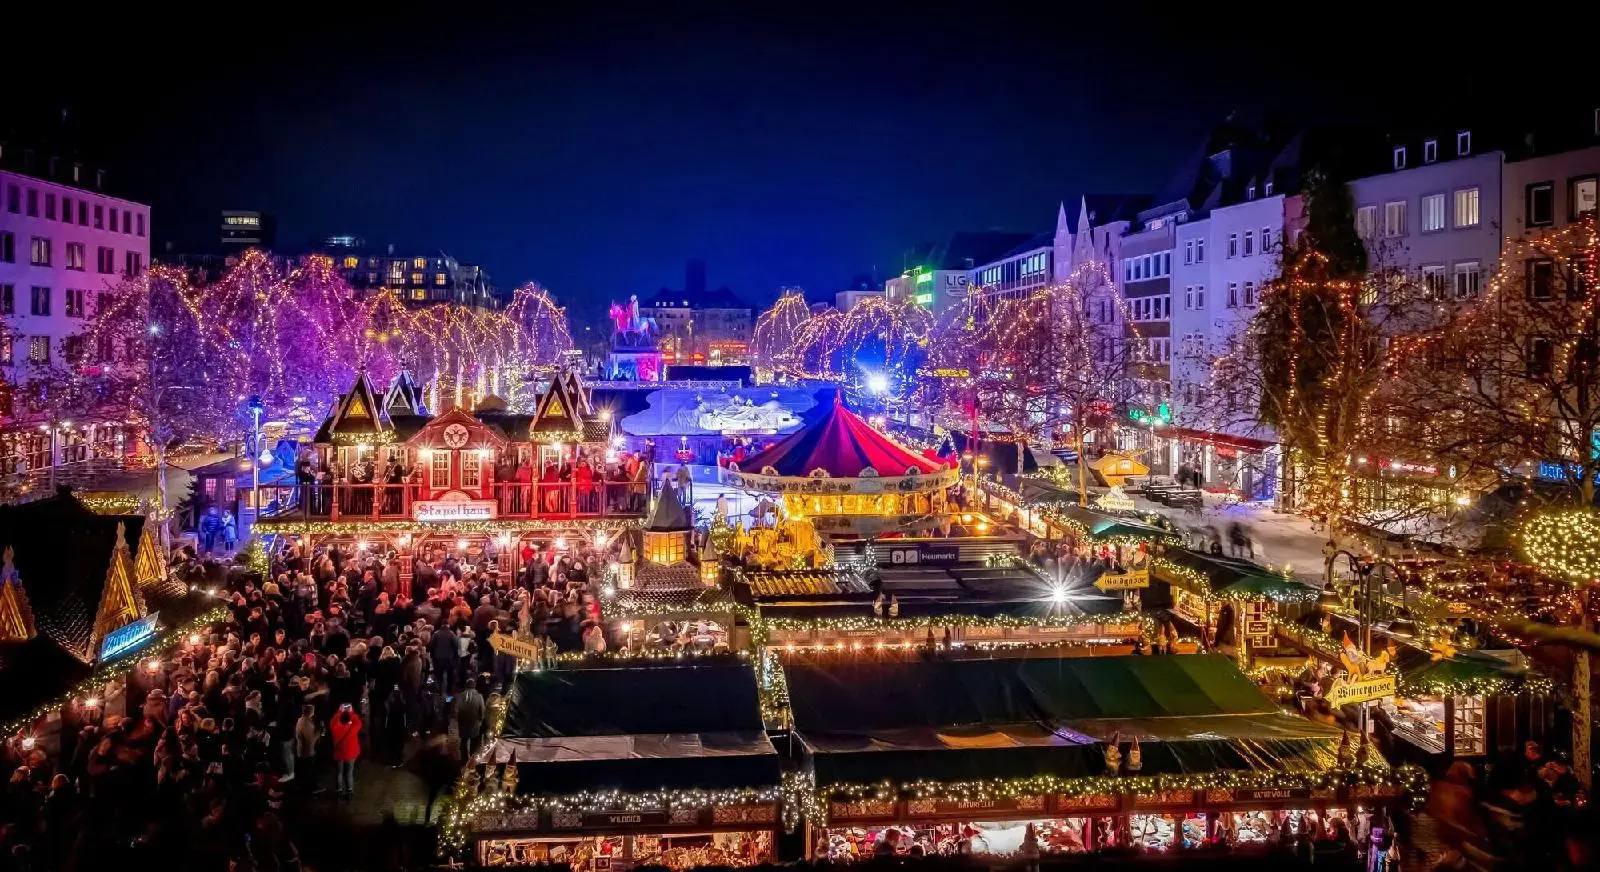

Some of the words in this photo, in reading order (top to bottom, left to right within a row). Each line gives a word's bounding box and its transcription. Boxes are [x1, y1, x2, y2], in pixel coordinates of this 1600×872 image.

[418, 504, 490, 516] Stapelhaus
[921, 552, 956, 560] Heumarkt
[1337, 682, 1391, 698] Wintergasse
